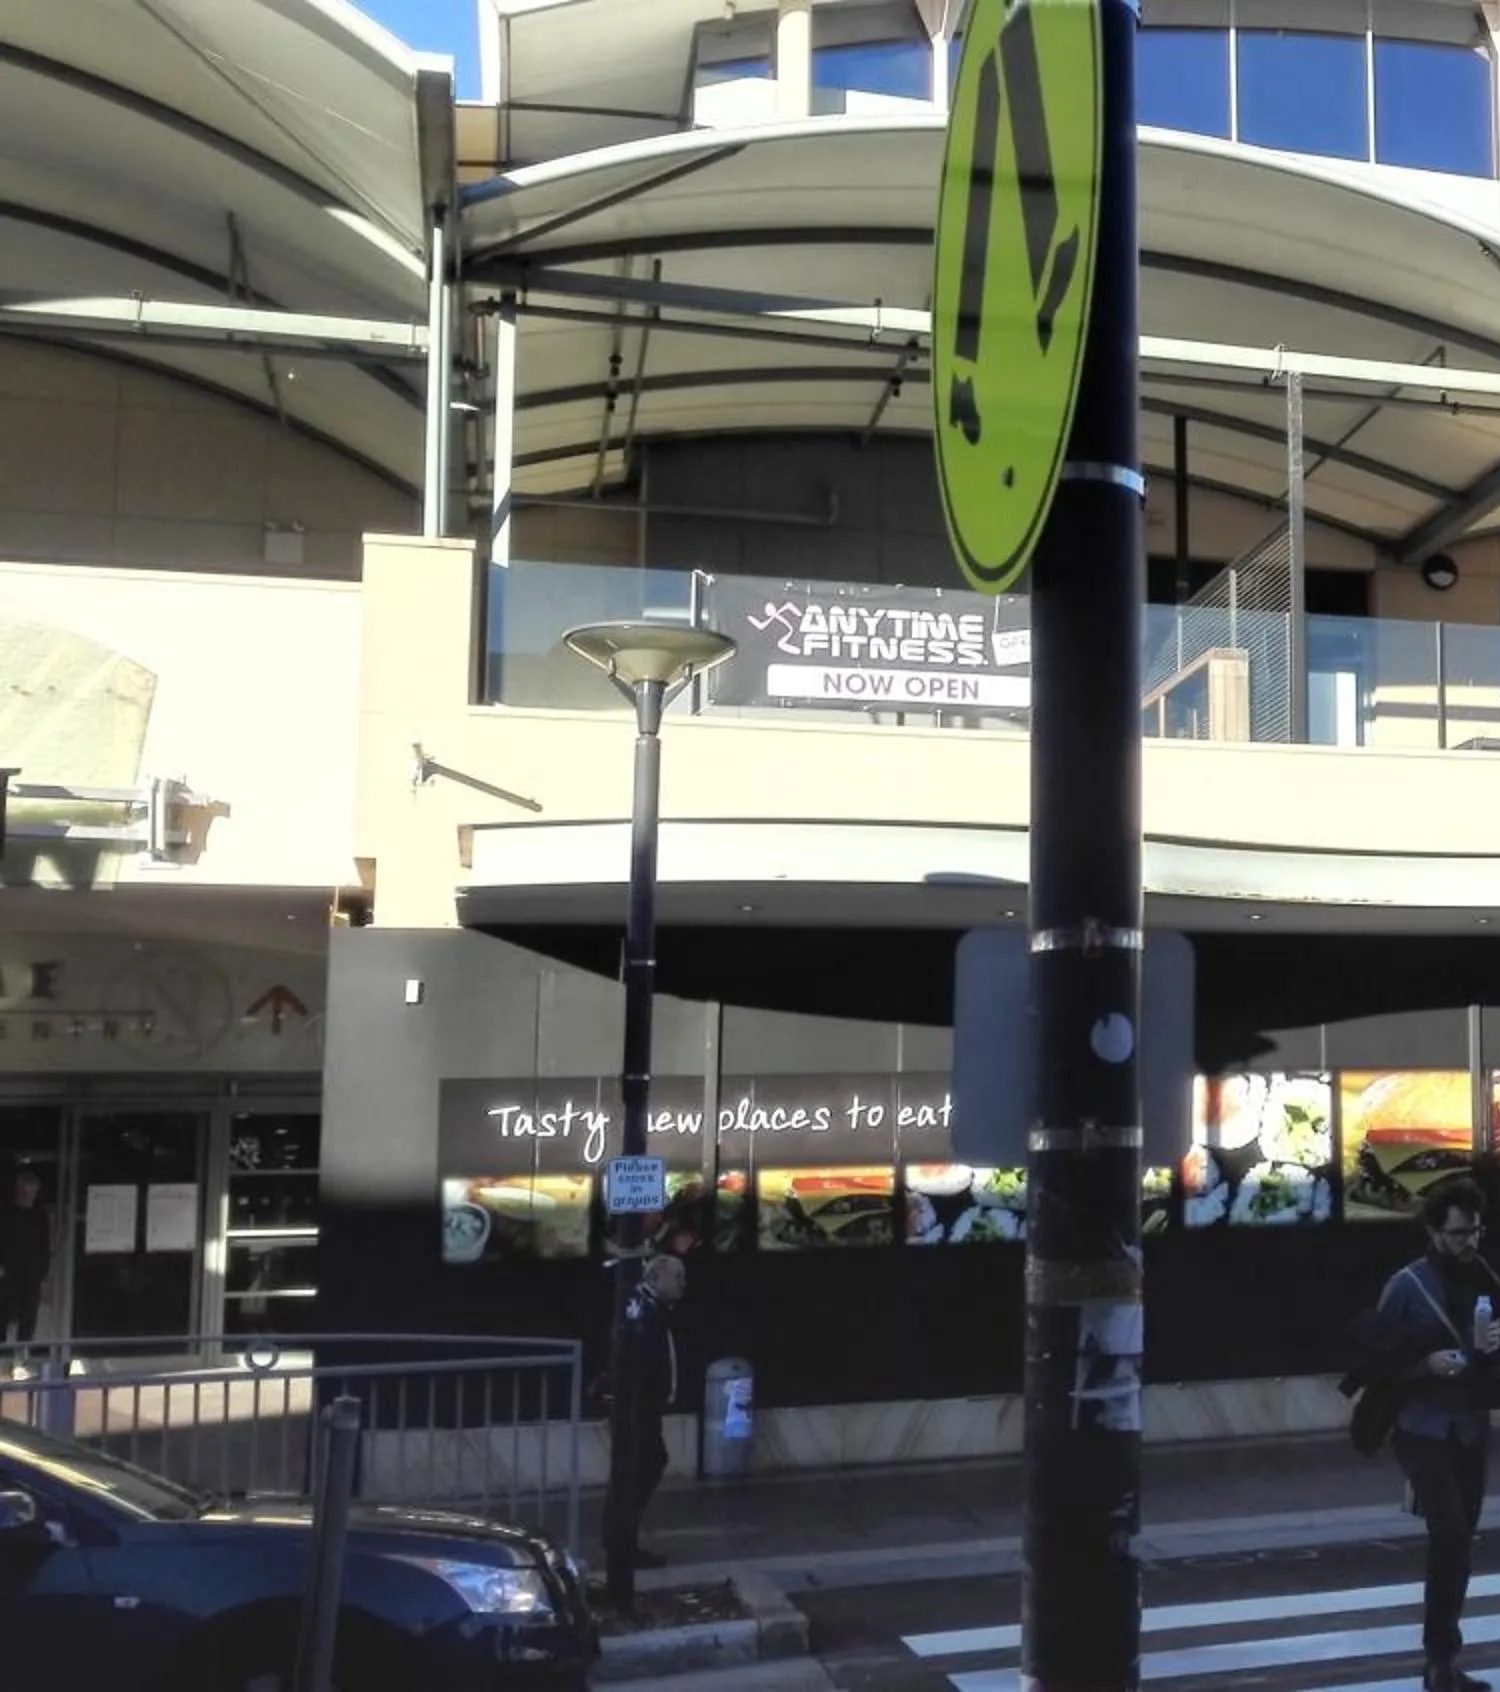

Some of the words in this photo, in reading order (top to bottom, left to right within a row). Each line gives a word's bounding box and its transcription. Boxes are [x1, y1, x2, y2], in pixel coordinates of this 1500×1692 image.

[799, 605, 985, 641] ANYTIME
[823, 672, 893, 696] NOW
[904, 677, 980, 700] OPEN
[489, 1099, 610, 1163] Tasty
[846, 1094, 884, 1129] to
[897, 1093, 954, 1127] eat
